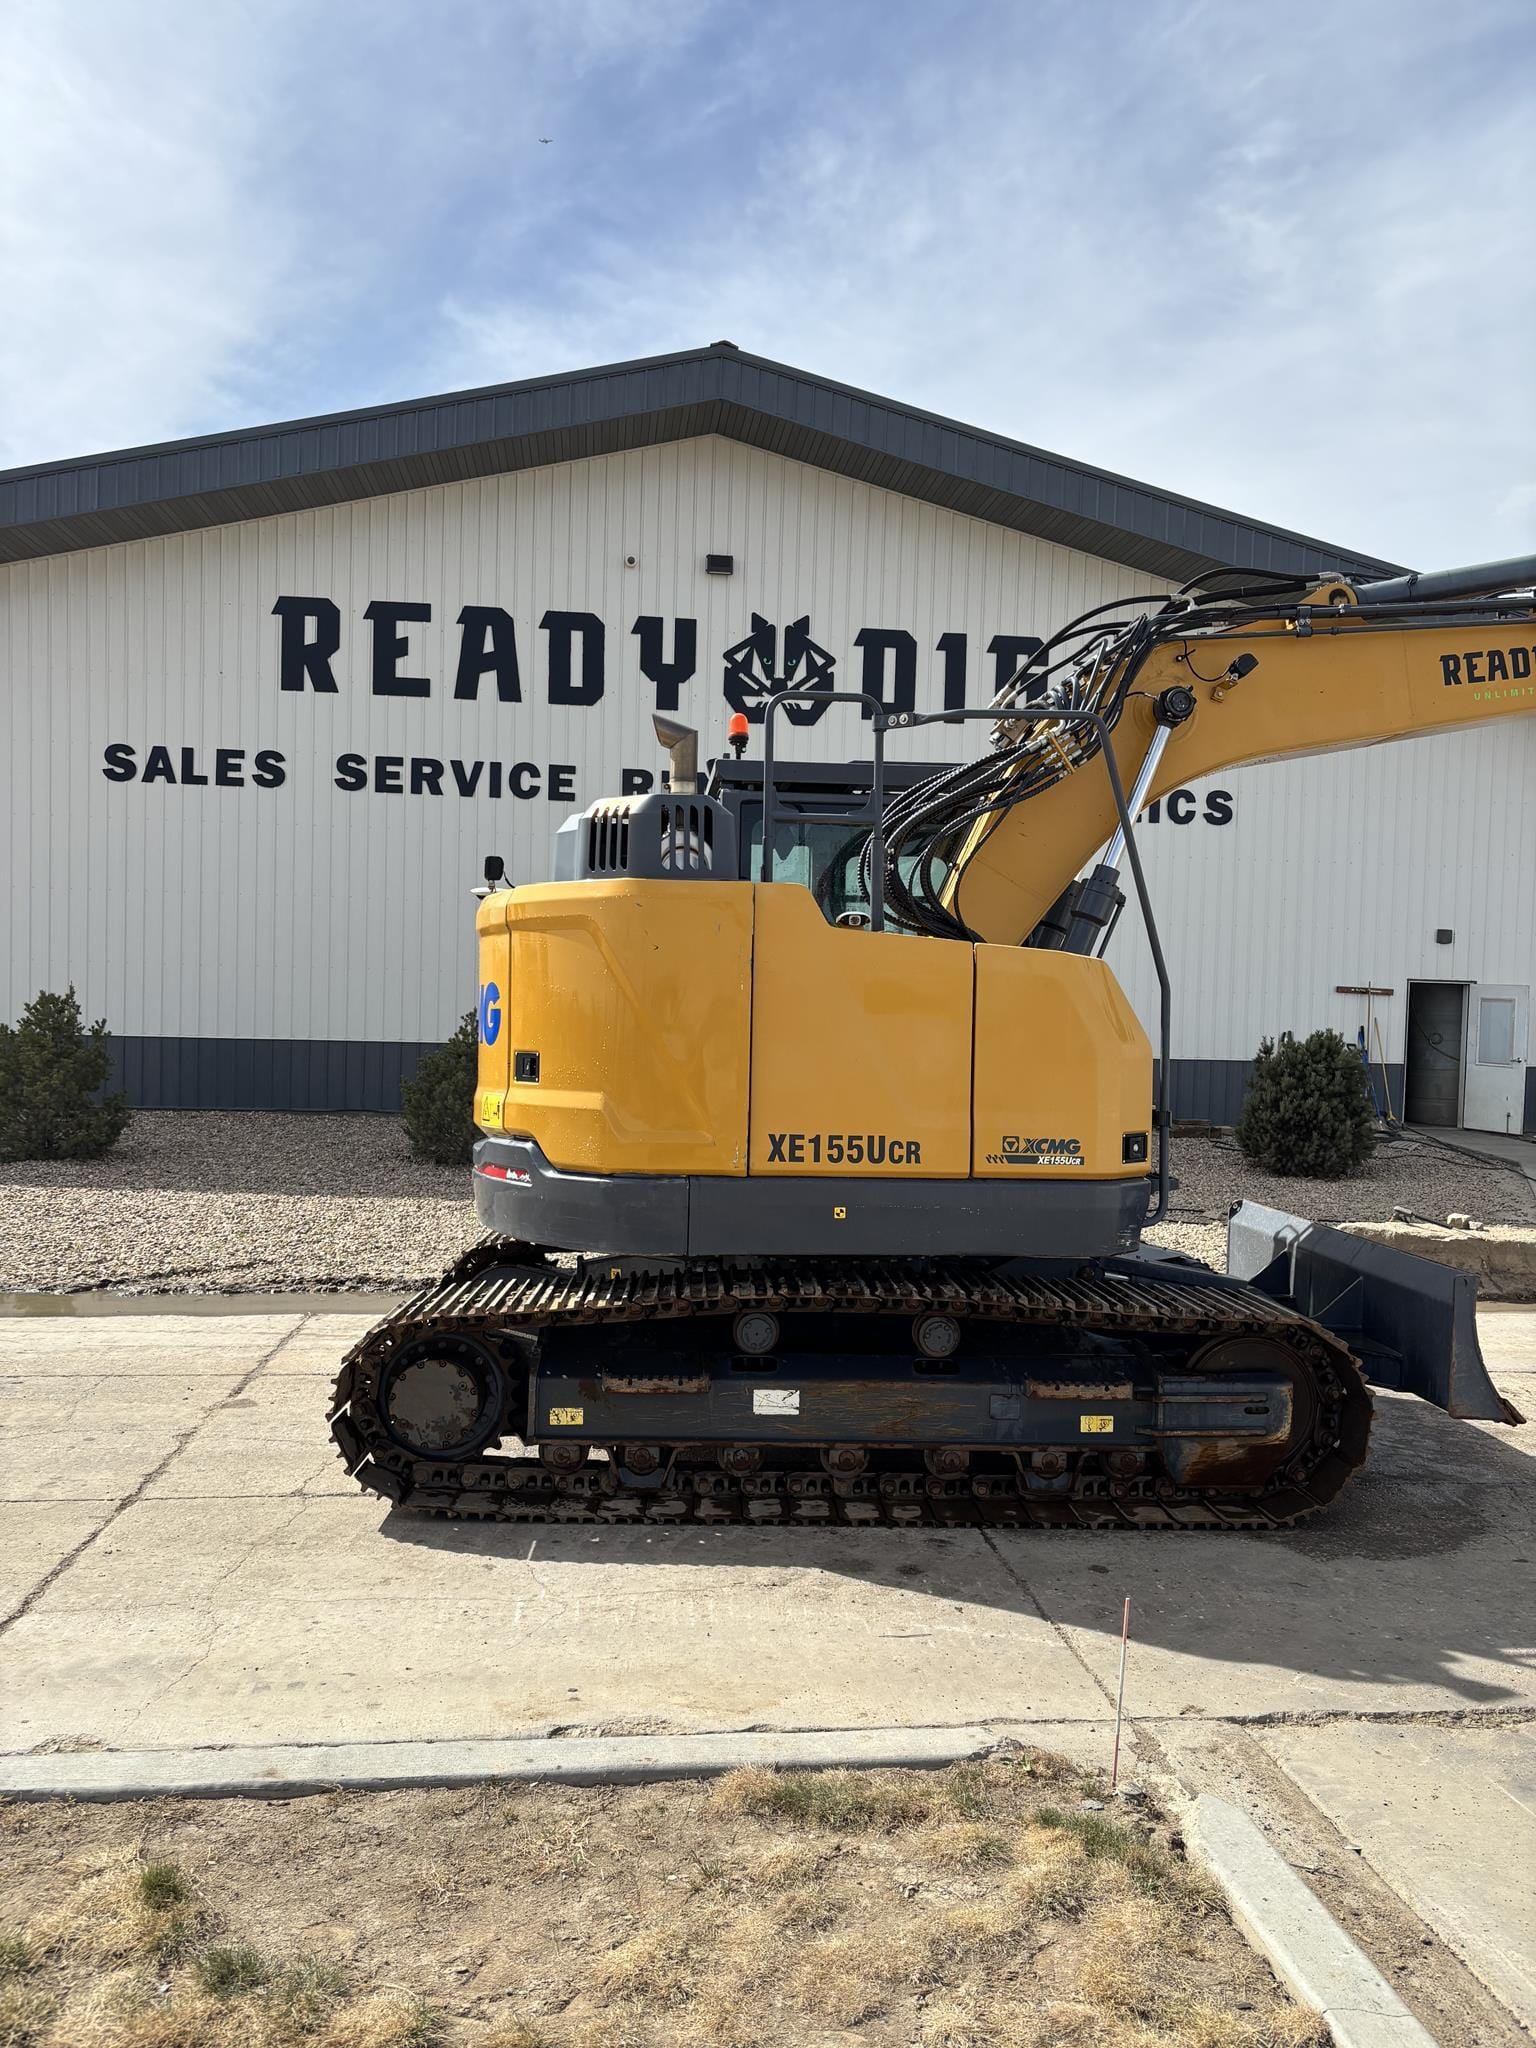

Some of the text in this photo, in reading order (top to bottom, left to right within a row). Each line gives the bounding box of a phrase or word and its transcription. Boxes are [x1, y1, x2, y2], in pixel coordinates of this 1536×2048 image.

[271, 595, 697, 711] READY
[102, 743, 286, 788] SALES
[334, 753, 576, 802] SERVICE
[1020, 1138, 1081, 1155] XCMG
